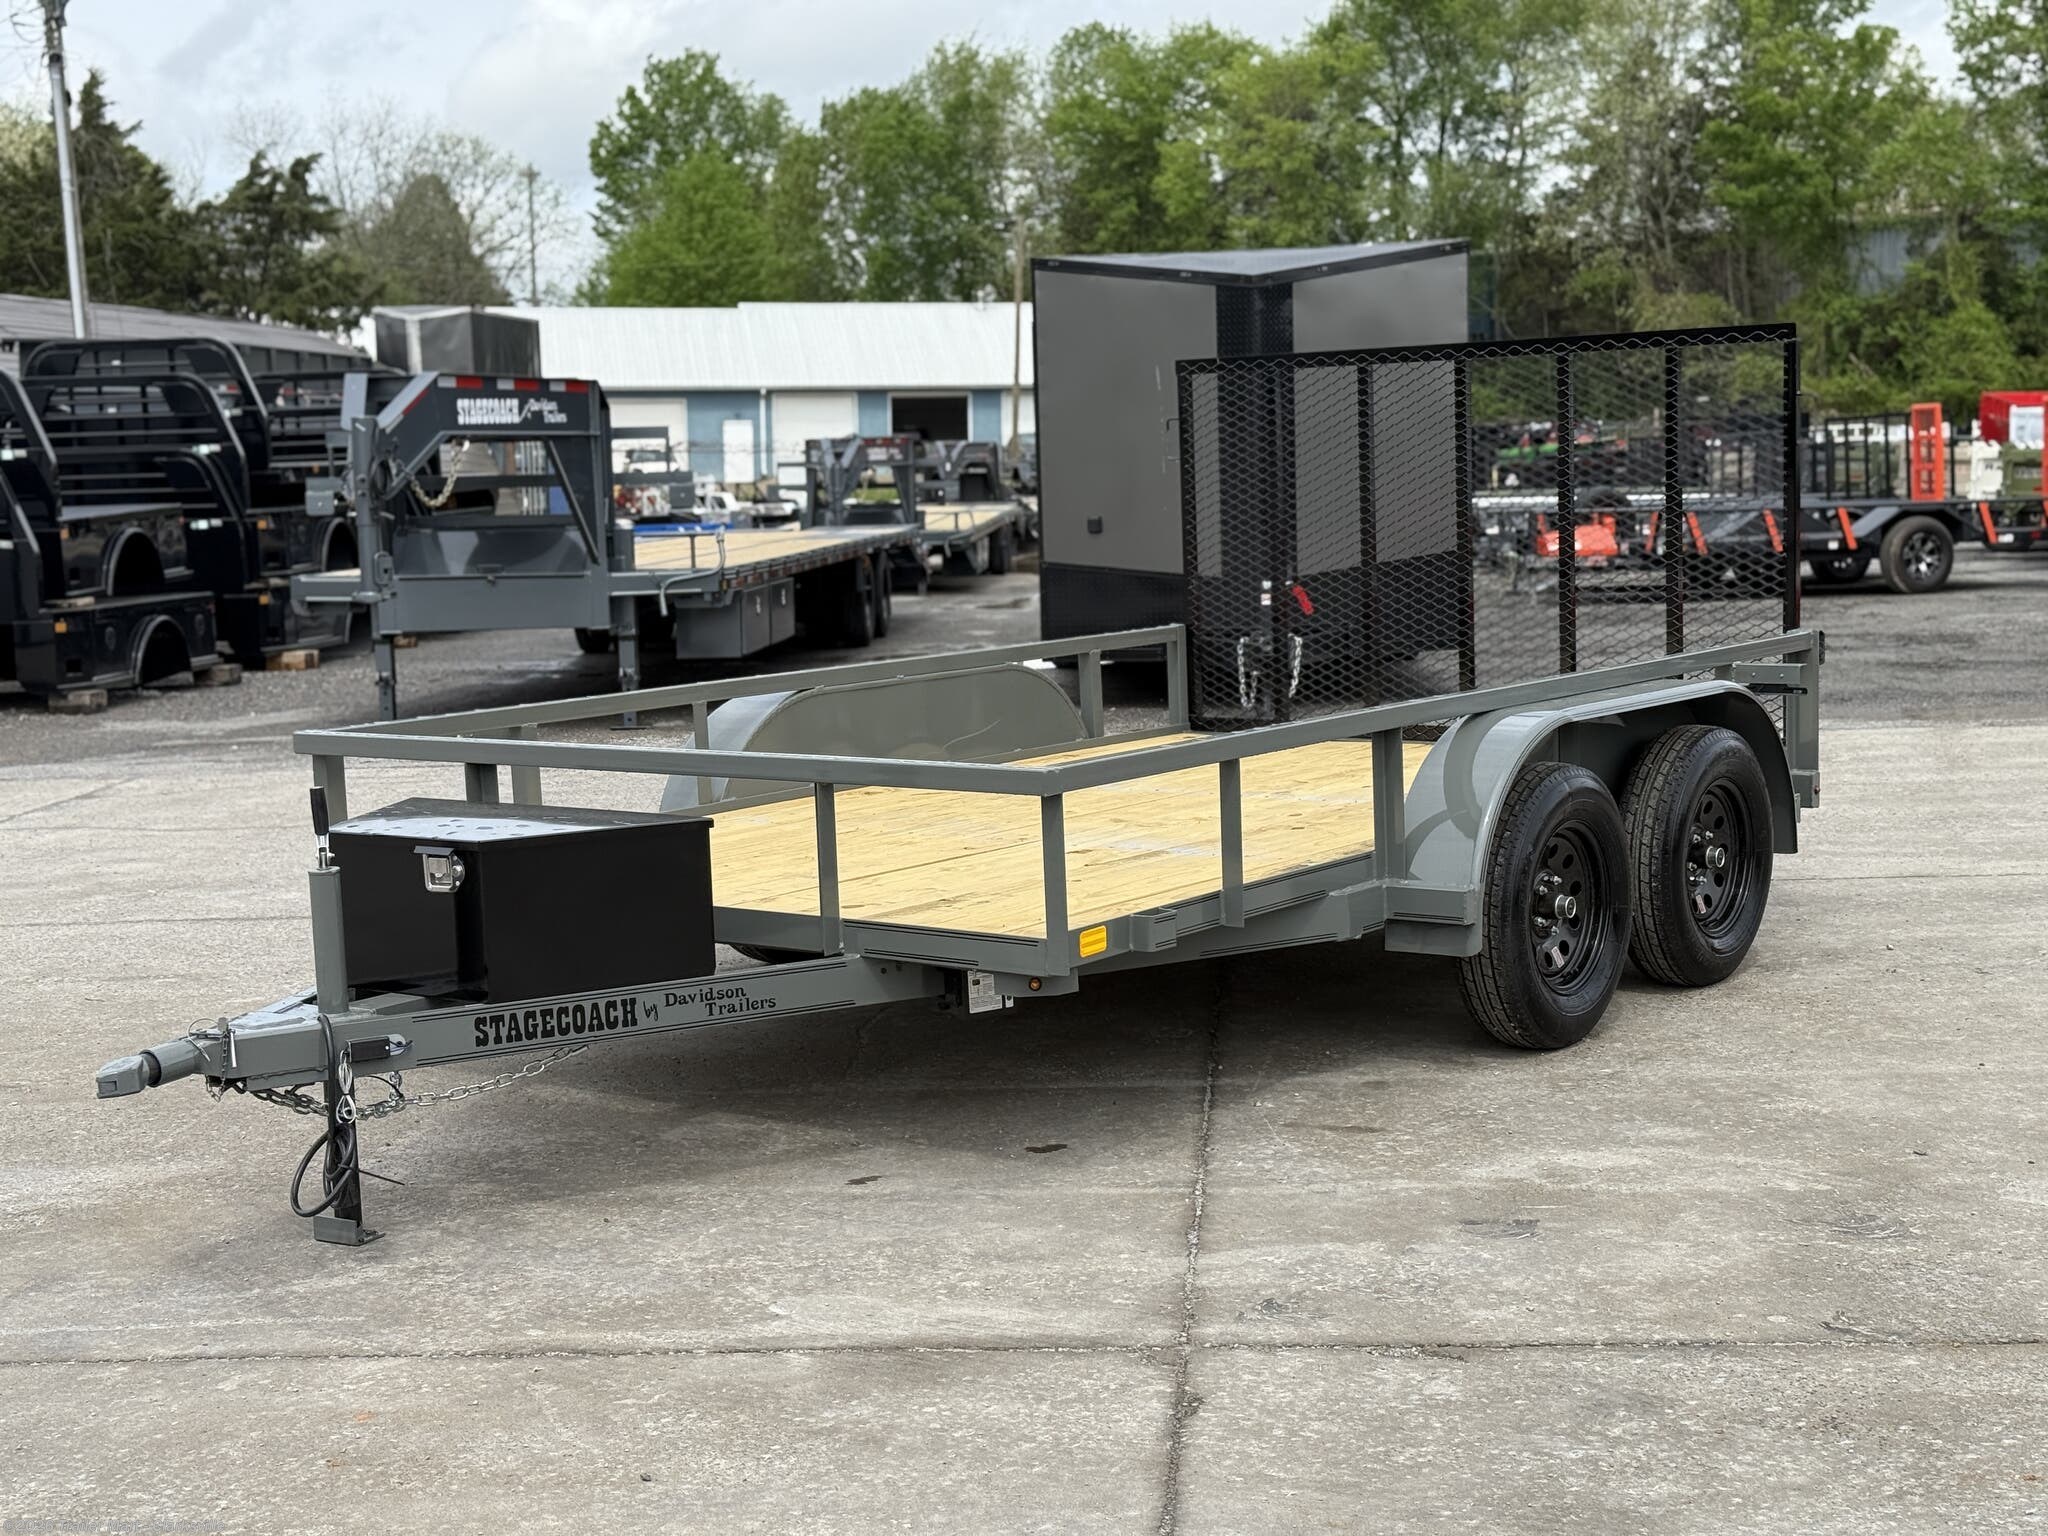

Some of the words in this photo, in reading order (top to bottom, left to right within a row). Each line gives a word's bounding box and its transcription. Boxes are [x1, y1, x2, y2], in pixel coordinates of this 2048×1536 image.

[457, 398, 519, 425] STAGECOACH
[474, 997, 638, 1047] STAGECOACH
[644, 1000, 660, 1022] by
[664, 985, 747, 1008] Davidson
[704, 997, 777, 1018] Trailers
